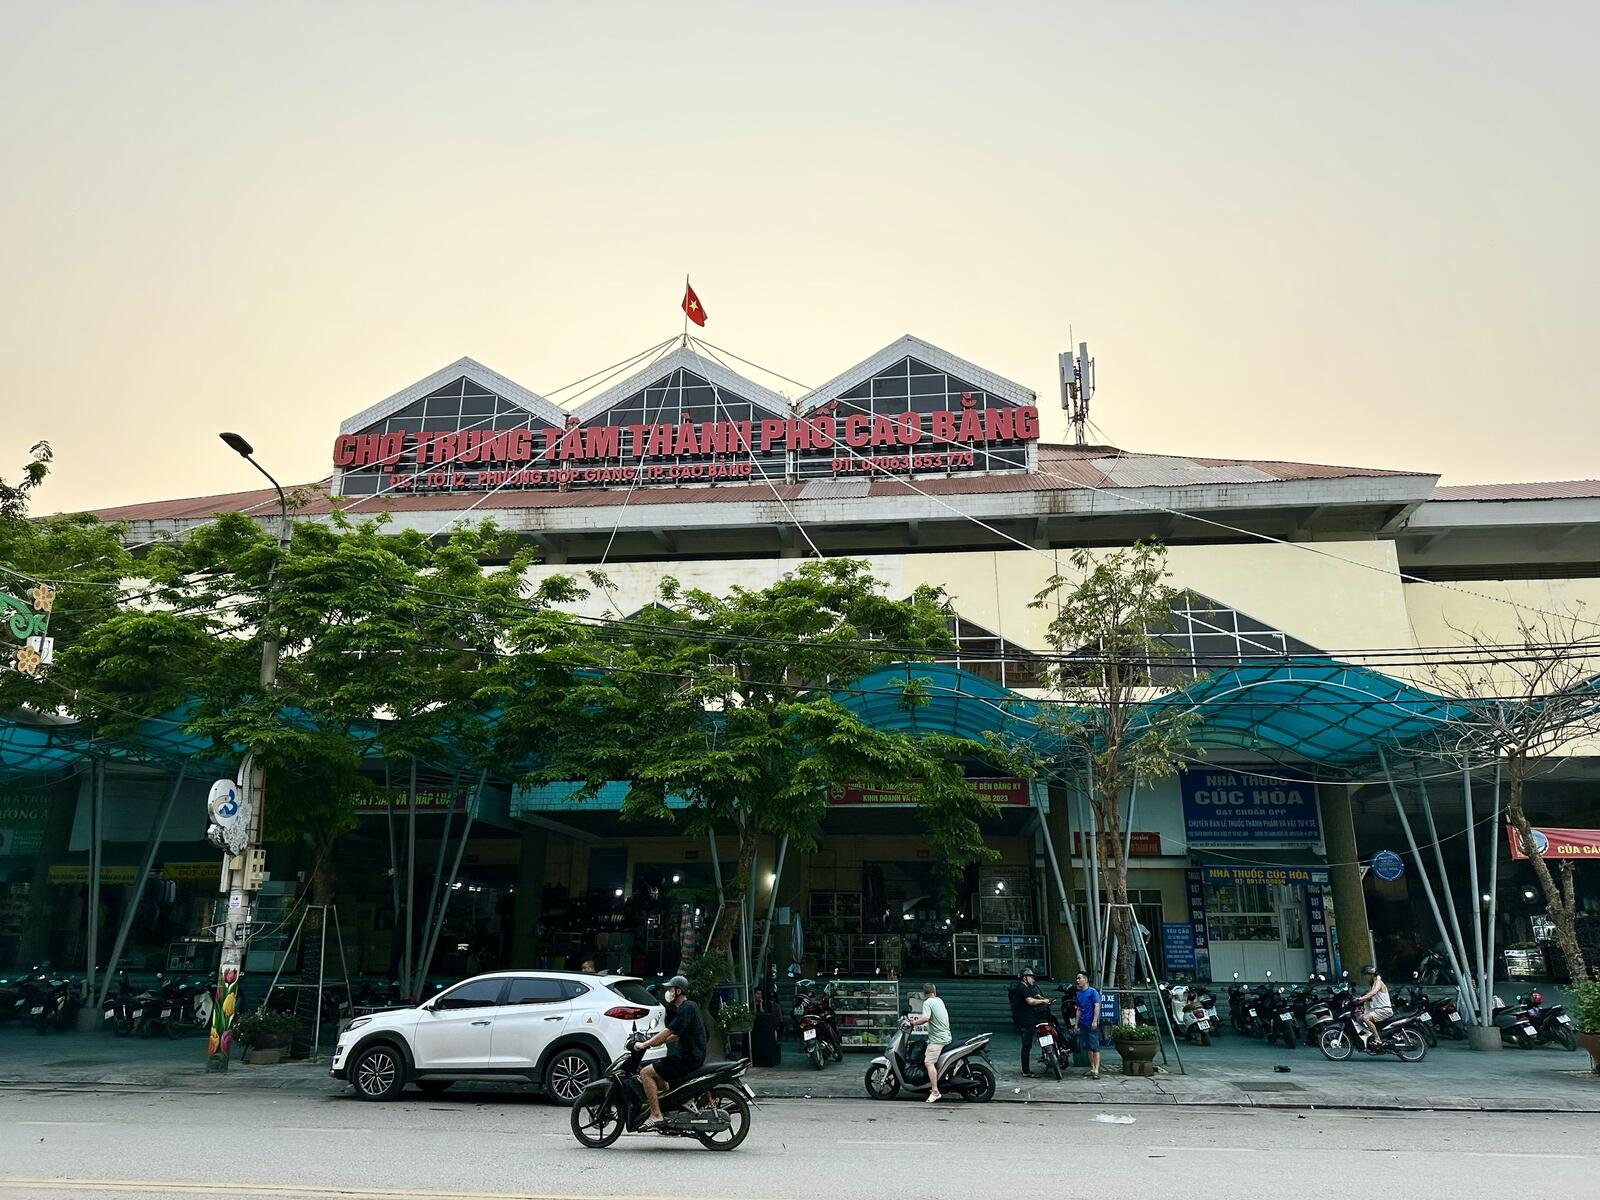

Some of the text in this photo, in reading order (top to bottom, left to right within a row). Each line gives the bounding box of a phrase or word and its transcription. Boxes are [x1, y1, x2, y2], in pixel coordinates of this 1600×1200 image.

[333, 392, 1040, 473] CHỢ TRUNG TÂM THÀNH PHỐ CAO BẰNG
[427, 466, 447, 486] TỔ
[478, 466, 543, 486] PHƯỜNG
[547, 469, 579, 486] HỢP
[669, 464, 703, 478] CAO
[708, 455, 752, 478] BẰNG
[862, 455, 910, 471] 02063
[914, 454, 943, 468] 853
[1206, 771, 1288, 787] NHÀ THUỐC
[415, 790, 434, 805] HÁP
[992, 794, 1008, 802] 2023
[1194, 787, 1304, 805] CÚC HÒA
[1557, 843, 1600, 854] CỦA CÁ
[1209, 867, 1230, 878] NHÀ
[1232, 866, 1264, 879] THUỐC
[1266, 869, 1286, 879] CÚC
[1289, 869, 1309, 880] HÒA
